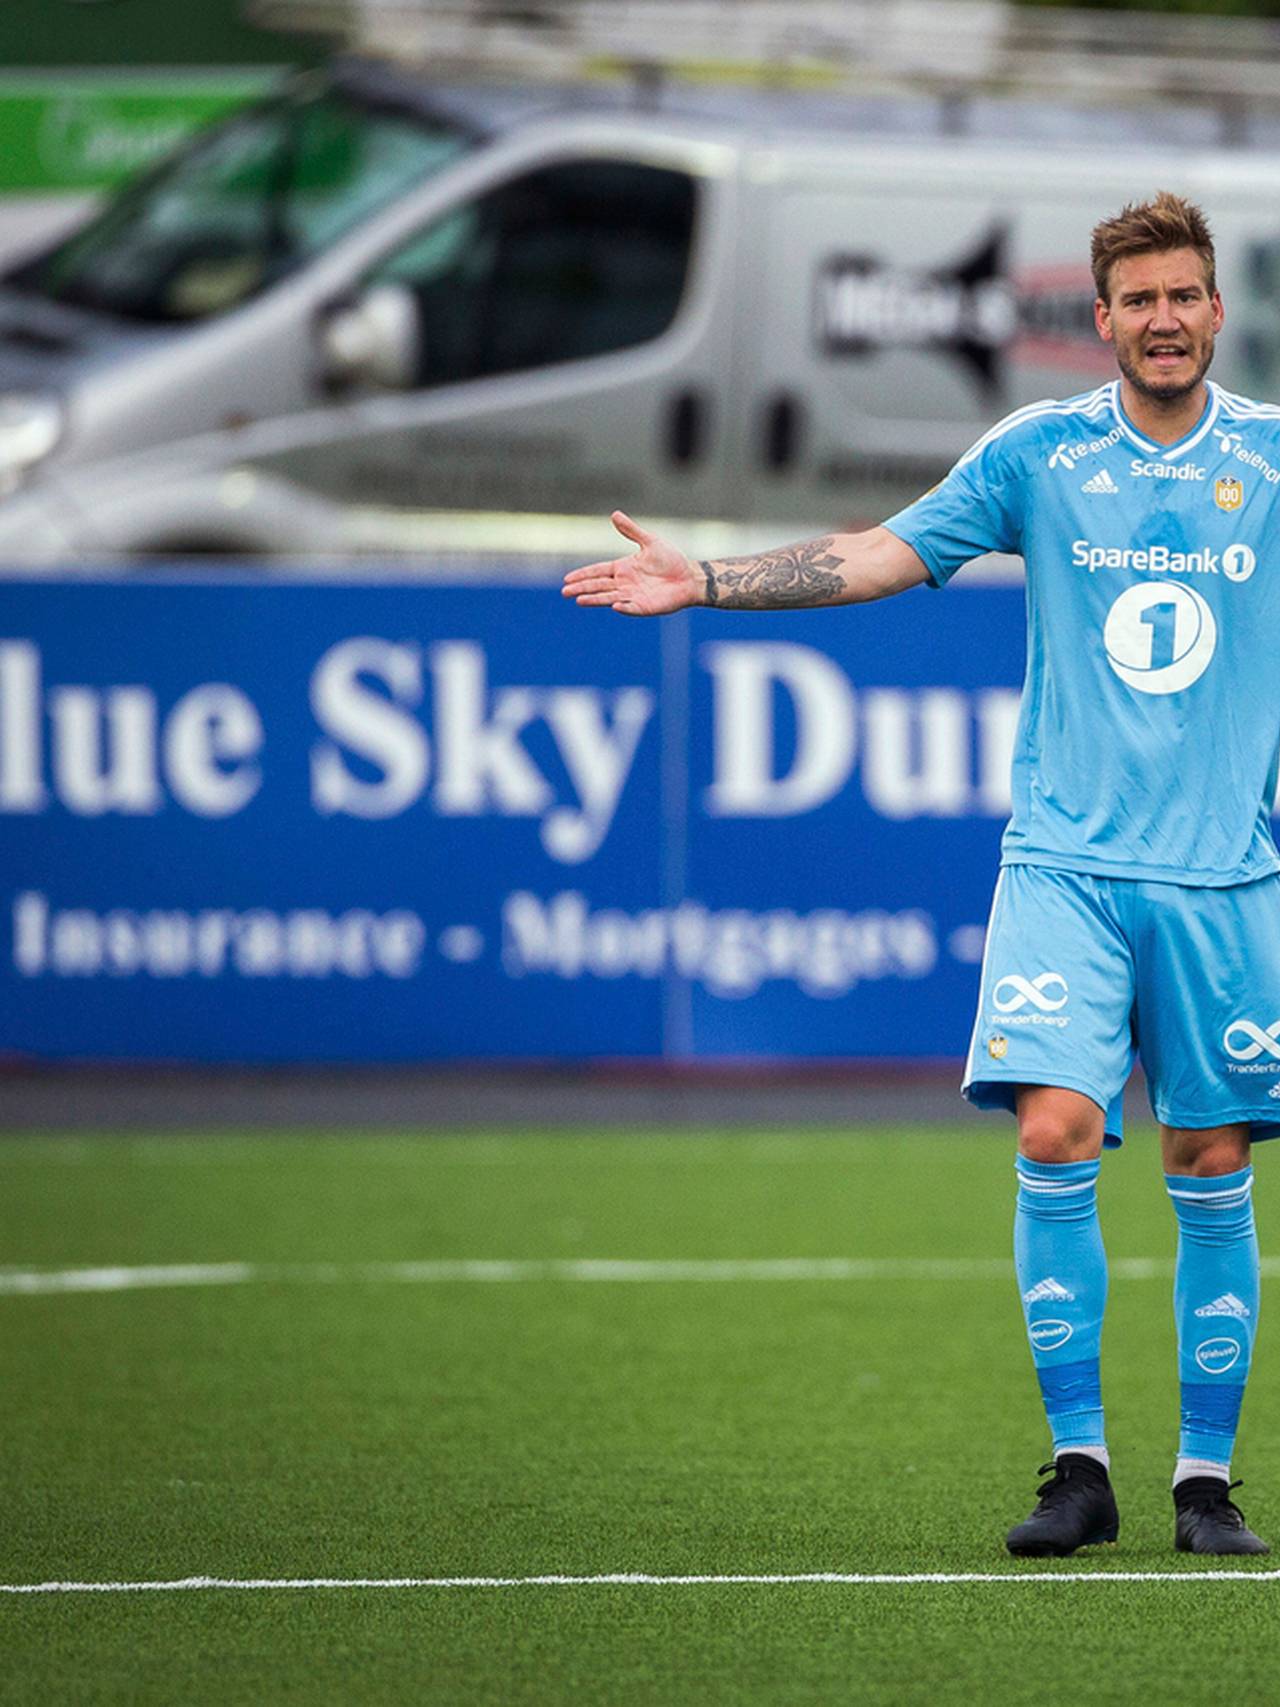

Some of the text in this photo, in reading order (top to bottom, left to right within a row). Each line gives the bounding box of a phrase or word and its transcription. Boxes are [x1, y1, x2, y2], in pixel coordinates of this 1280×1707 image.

[1067, 426, 1124, 460] teenor
[1129, 459, 1206, 481] Scandic
[1218, 486, 1239, 503] 100
[1071, 540, 1219, 574] SpareBank
[309, 635, 655, 863] Sky
[14, 892, 426, 979] Insurance
[503, 892, 938, 999] Mortgages
